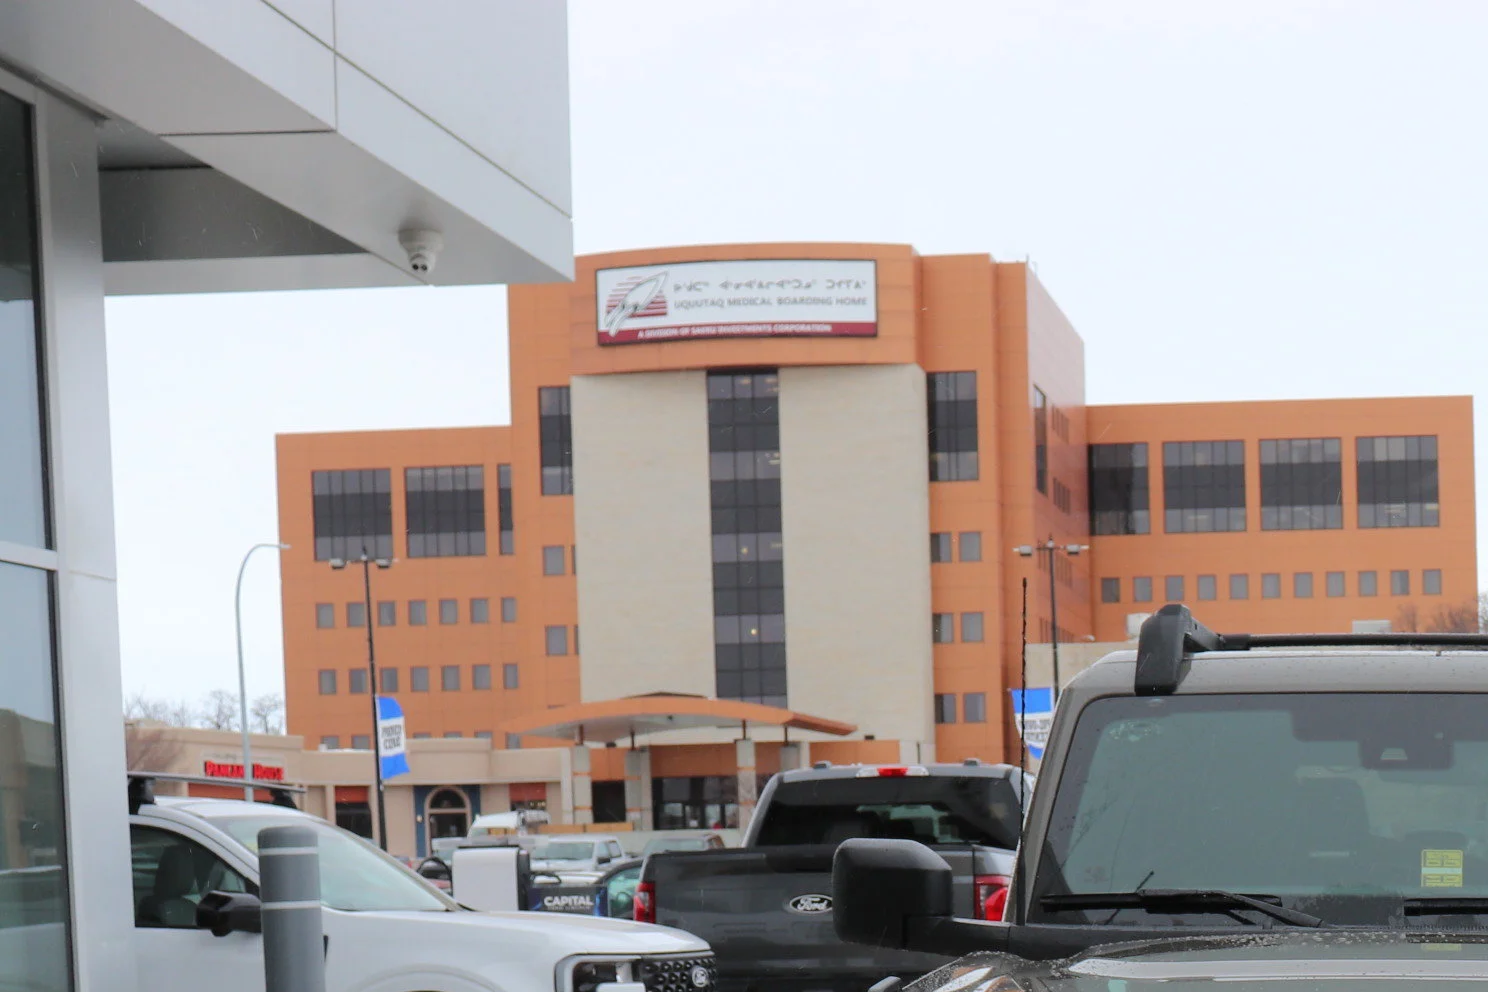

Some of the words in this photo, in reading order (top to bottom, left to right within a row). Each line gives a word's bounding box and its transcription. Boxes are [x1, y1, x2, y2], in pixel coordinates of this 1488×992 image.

[727, 297, 773, 306] MEDICAL
[777, 296, 833, 305] BOARDING
[835, 296, 868, 305] HOME
[544, 895, 594, 906] CAPITAL
